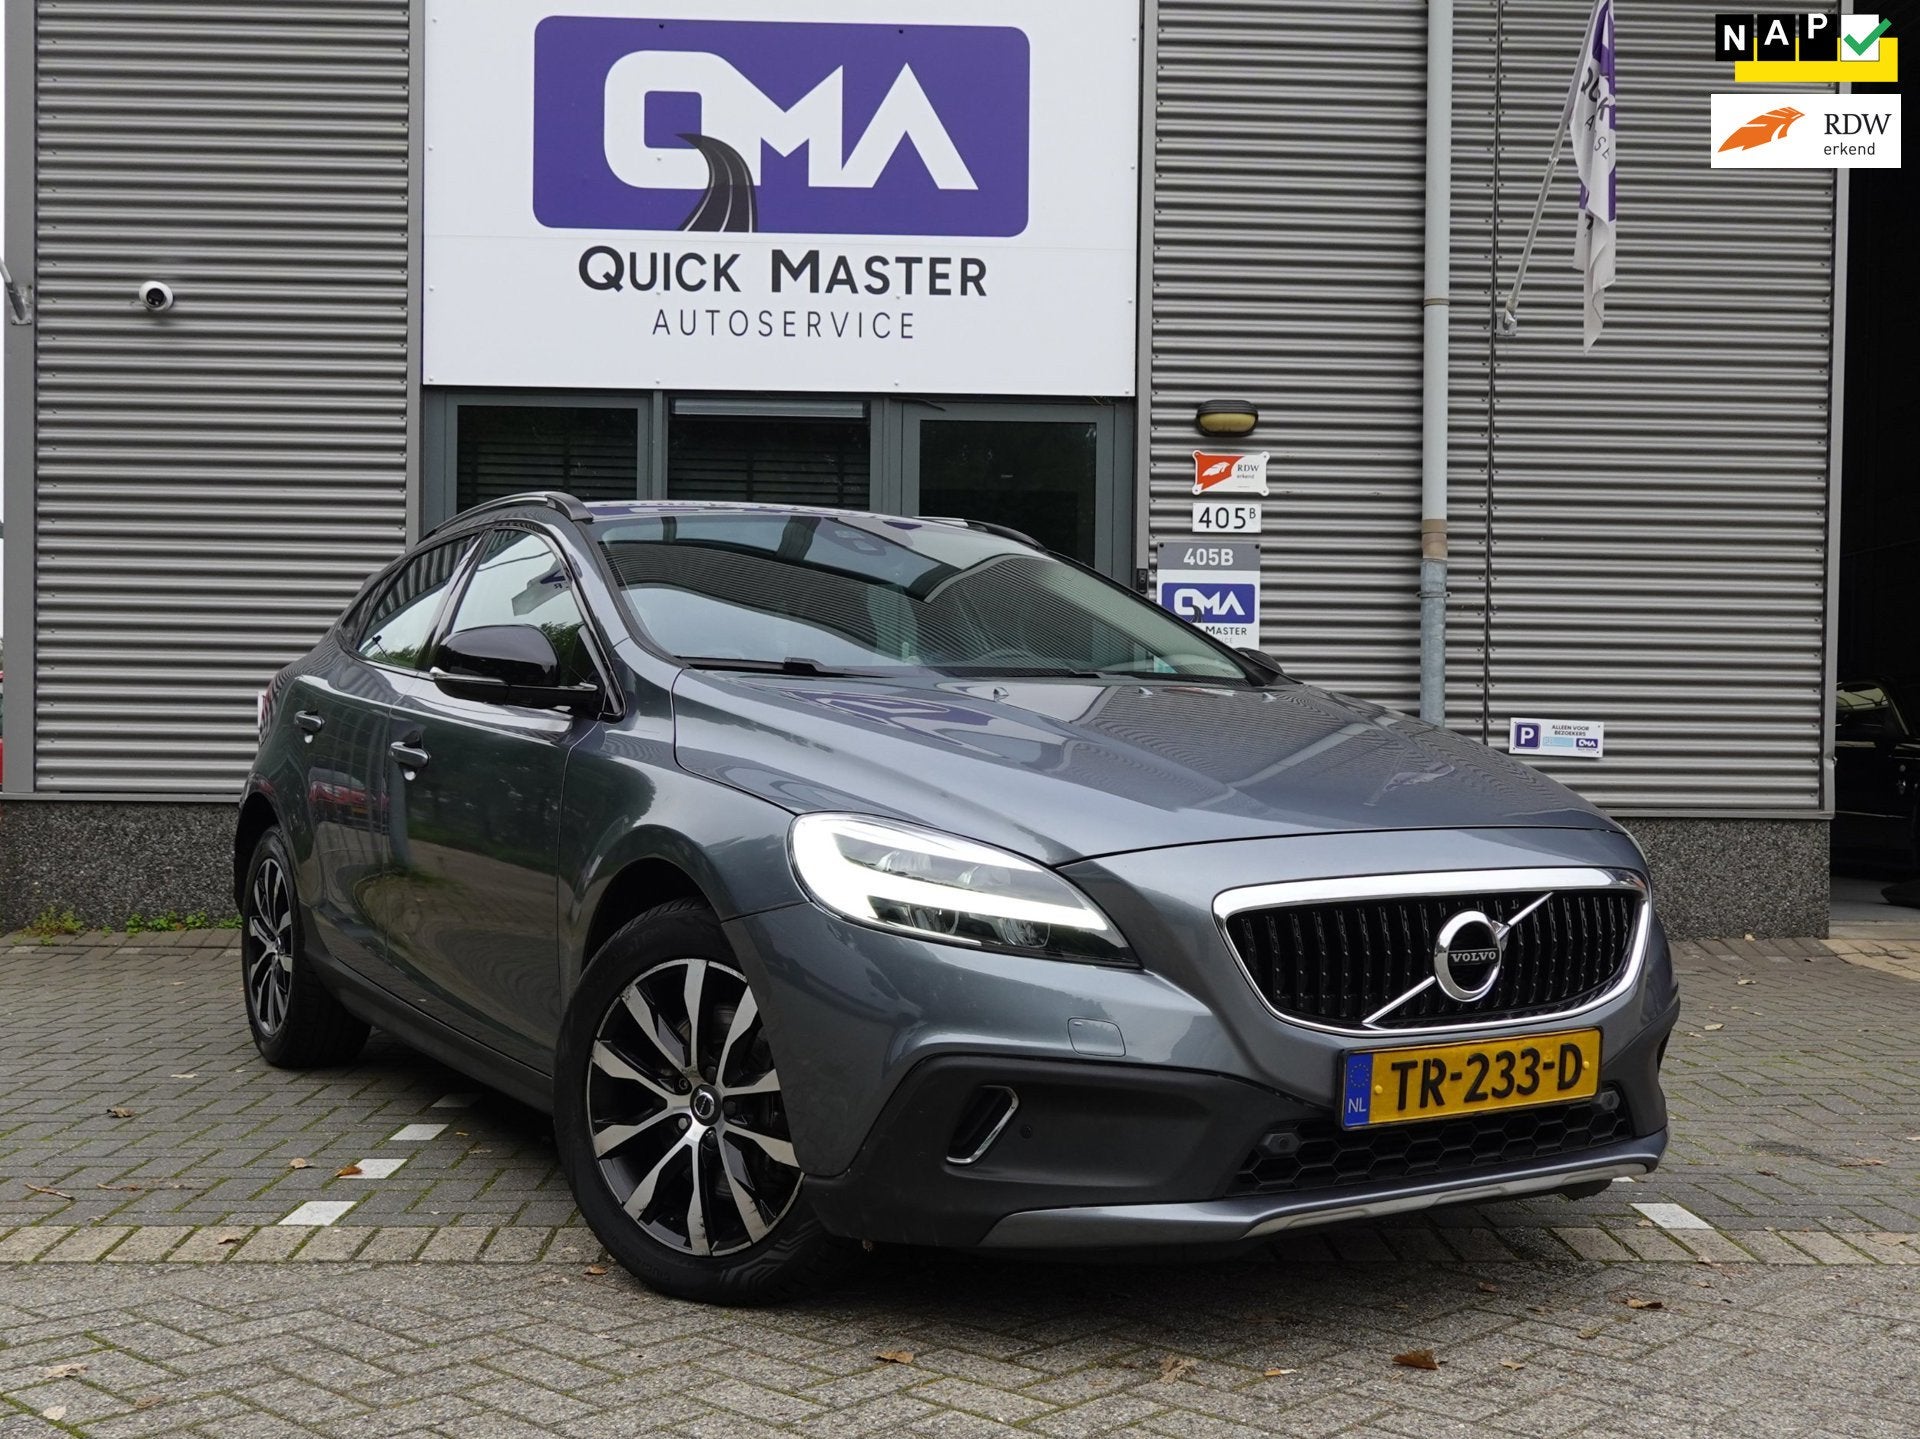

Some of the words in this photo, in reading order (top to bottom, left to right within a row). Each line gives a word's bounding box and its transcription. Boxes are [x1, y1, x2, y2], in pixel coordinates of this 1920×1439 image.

[578, 245, 742, 293] QUICK
[771, 249, 987, 297] MASTER
[652, 308, 915, 340] AUTOSERVICE
[1237, 463, 1260, 472] RDW
[1183, 548, 1234, 566] 405B
[1205, 625, 1247, 635] MASTER
[1520, 727, 1535, 745] P
[1450, 951, 1497, 963] VOLVO
[1391, 1043, 1583, 1111] TR-233-D
[1347, 1096, 1367, 1114] NL
